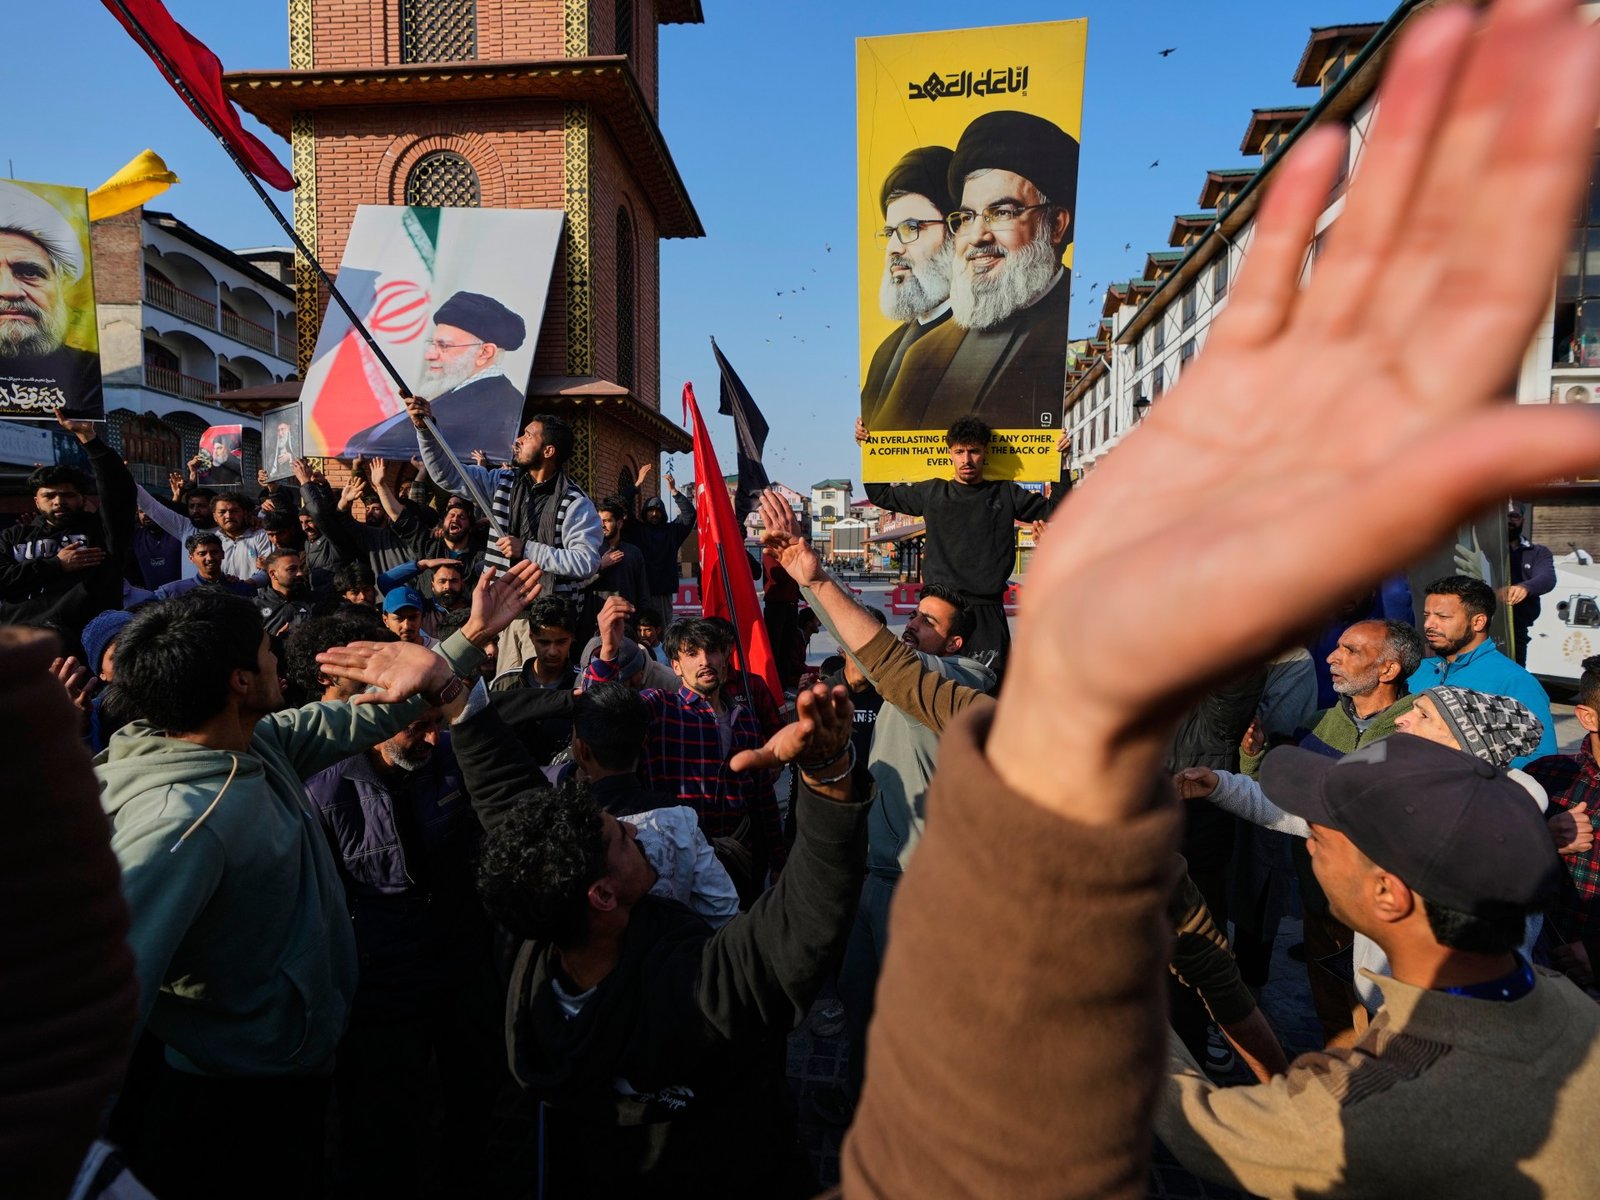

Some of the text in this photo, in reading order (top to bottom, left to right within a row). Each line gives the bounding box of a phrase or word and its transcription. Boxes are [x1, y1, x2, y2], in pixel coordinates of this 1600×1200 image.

[865, 436, 879, 444] AN
[880, 435, 940, 444] EVERLASTING
[999, 434, 1020, 443] ANY
[1021, 434, 1055, 443] OTHER.
[869, 448, 877, 456] A
[878, 447, 910, 456] COFFIN
[911, 447, 935, 455] THAT
[991, 446, 1050, 454] THE BACK OF
